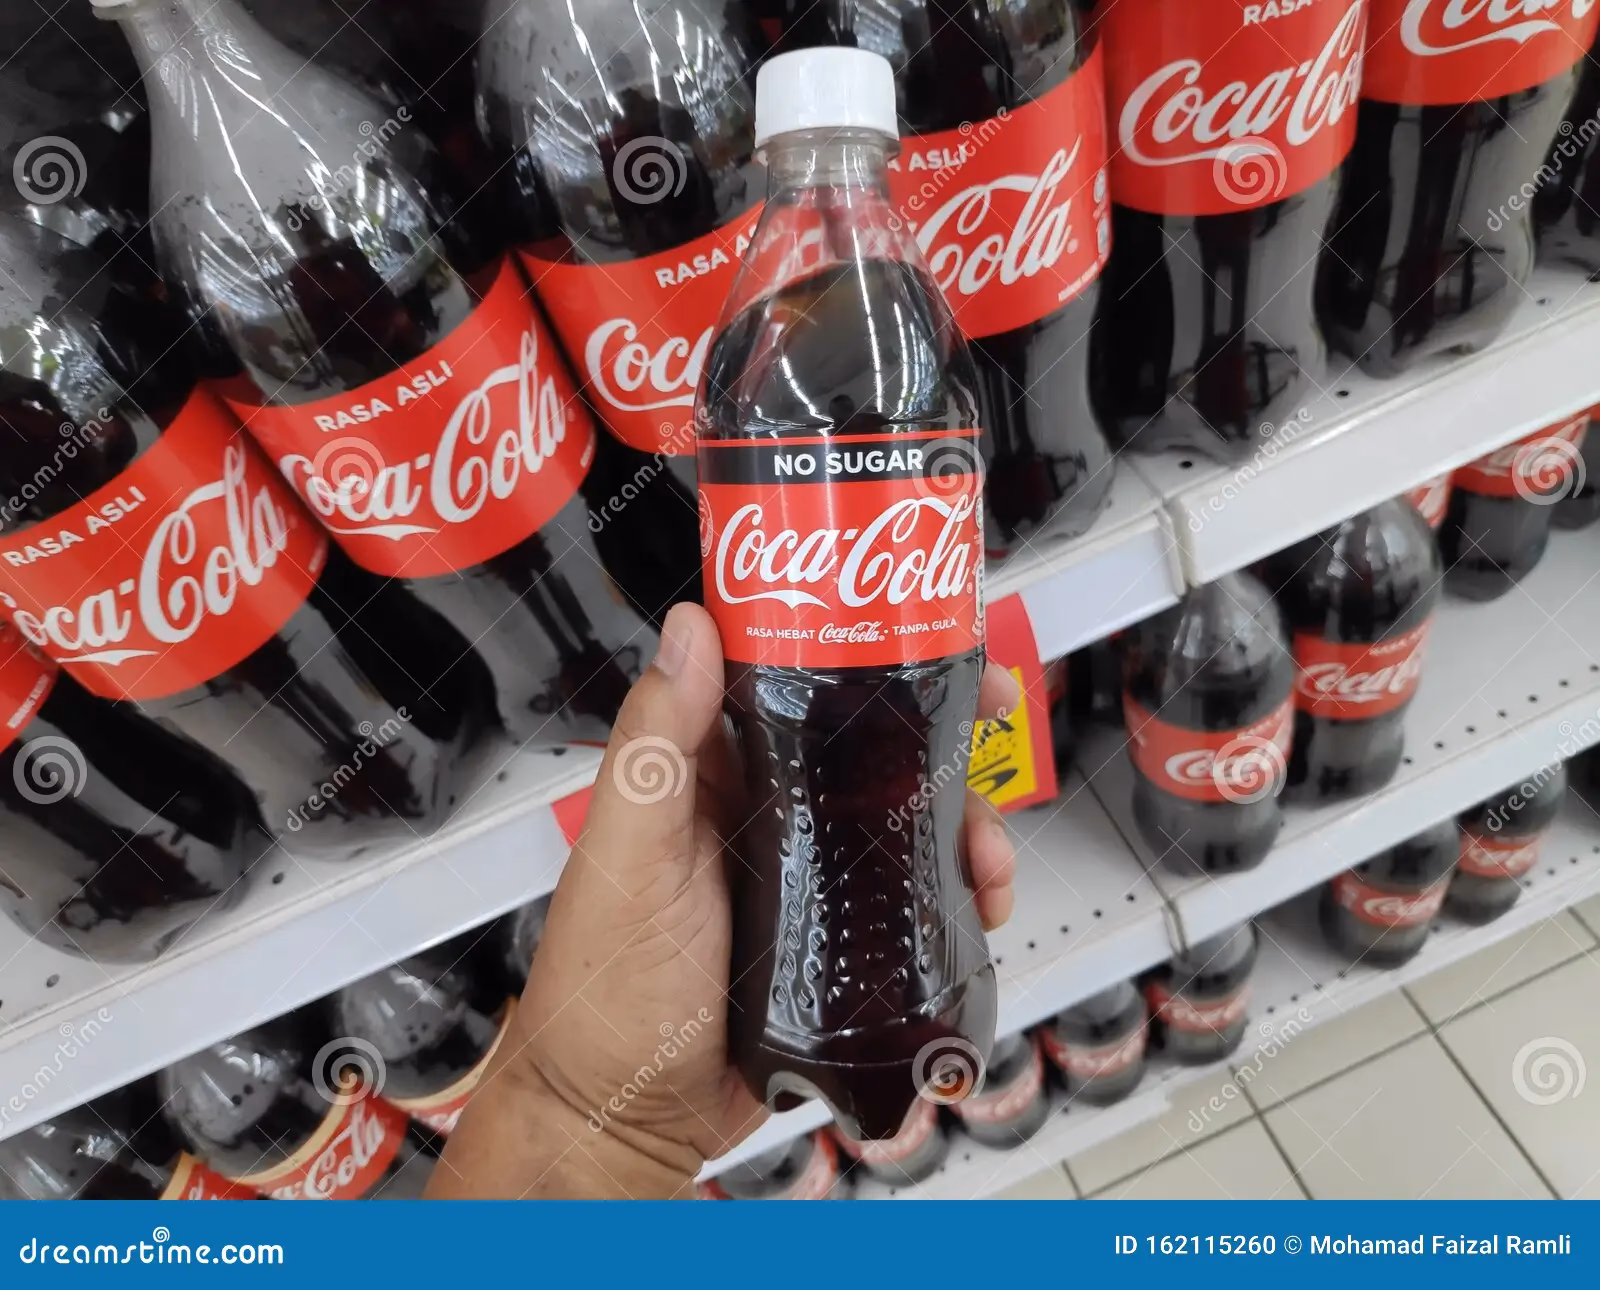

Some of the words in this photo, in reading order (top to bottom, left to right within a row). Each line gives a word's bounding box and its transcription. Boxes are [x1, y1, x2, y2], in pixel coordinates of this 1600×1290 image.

[655, 247, 729, 289] RASA
[279, 314, 567, 541] Coca-Cola
[313, 397, 393, 433] RASA
[397, 359, 454, 408] ASLI
[774, 454, 816, 476] NO
[825, 448, 923, 475] SUGAR
[0, 438, 289, 666] oca-Cola
[2, 529, 84, 568] RASA
[86, 485, 147, 535] ASLI
[715, 494, 977, 611] Coca-Cola
[746, 626, 773, 638] RASA
[776, 628, 816, 640] HEBAT
[818, 620, 883, 644] Coca-Cola
[892, 622, 929, 636] TANPA
[932, 618, 957, 631] GULA
